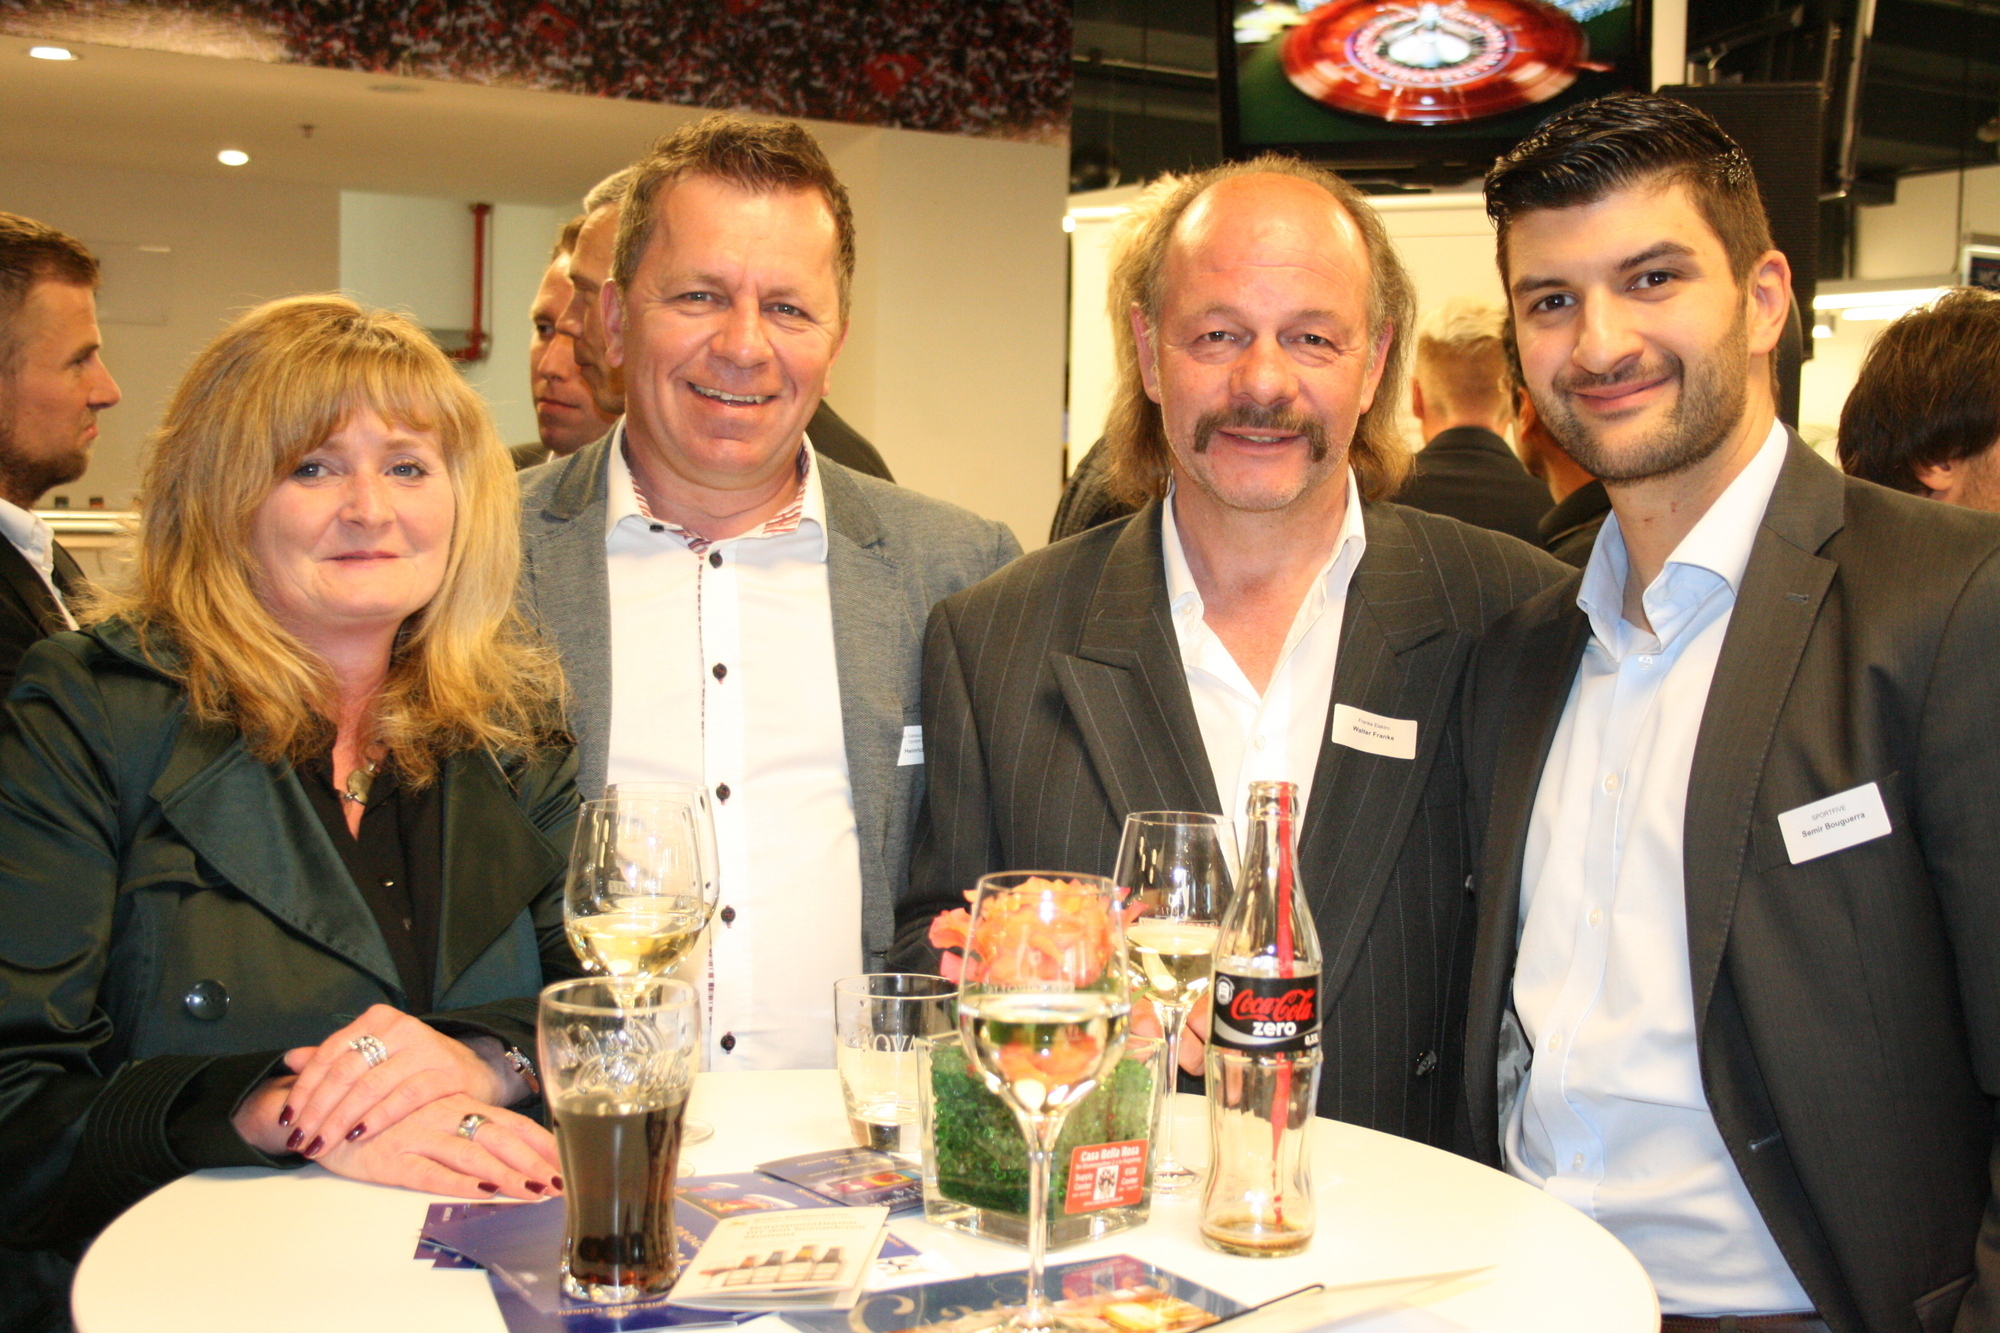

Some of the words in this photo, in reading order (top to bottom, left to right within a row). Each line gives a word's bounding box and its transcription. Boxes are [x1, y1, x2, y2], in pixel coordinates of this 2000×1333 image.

[1353, 725, 1371, 736] Walter
[1372, 731, 1395, 741] Franke
[1811, 804, 1847, 822] SPORTFIVE
[1824, 812, 1866, 831] Bouguerra
[1230, 988, 1316, 1022] Coca-Cola
[1252, 1021, 1297, 1036] zero
[1081, 1150, 1099, 1162] Casa
[1101, 1147, 1120, 1159] Bella
[1121, 1145, 1140, 1157] Rosa
[1074, 1182, 1092, 1191] Center
[1121, 1177, 1138, 1185] Center
